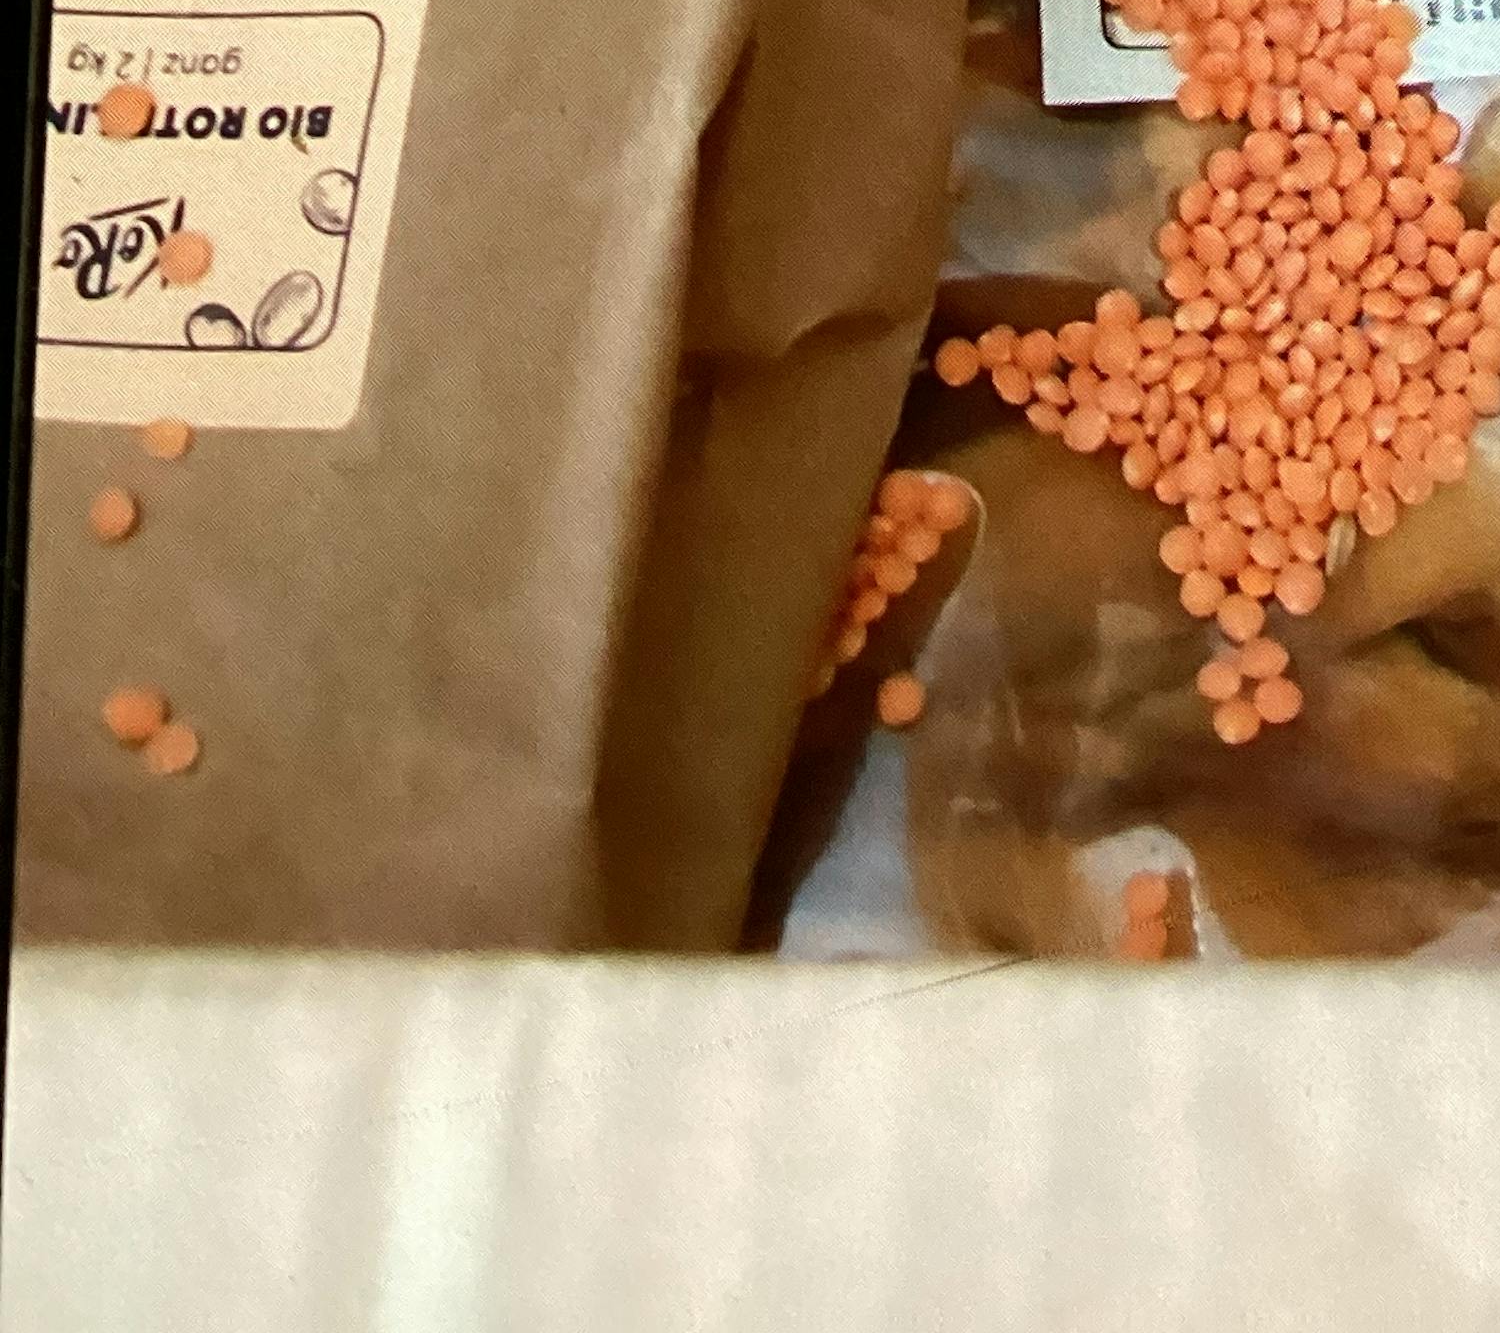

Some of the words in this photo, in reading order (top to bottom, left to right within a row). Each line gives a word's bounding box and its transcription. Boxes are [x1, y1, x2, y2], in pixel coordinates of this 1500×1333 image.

[66, 42, 104, 80] kg
[114, 51, 134, 80] 2
[162, 46, 239, 75] ganz
[257, 104, 332, 139] BIO
[51, 195, 184, 300] KoRo
